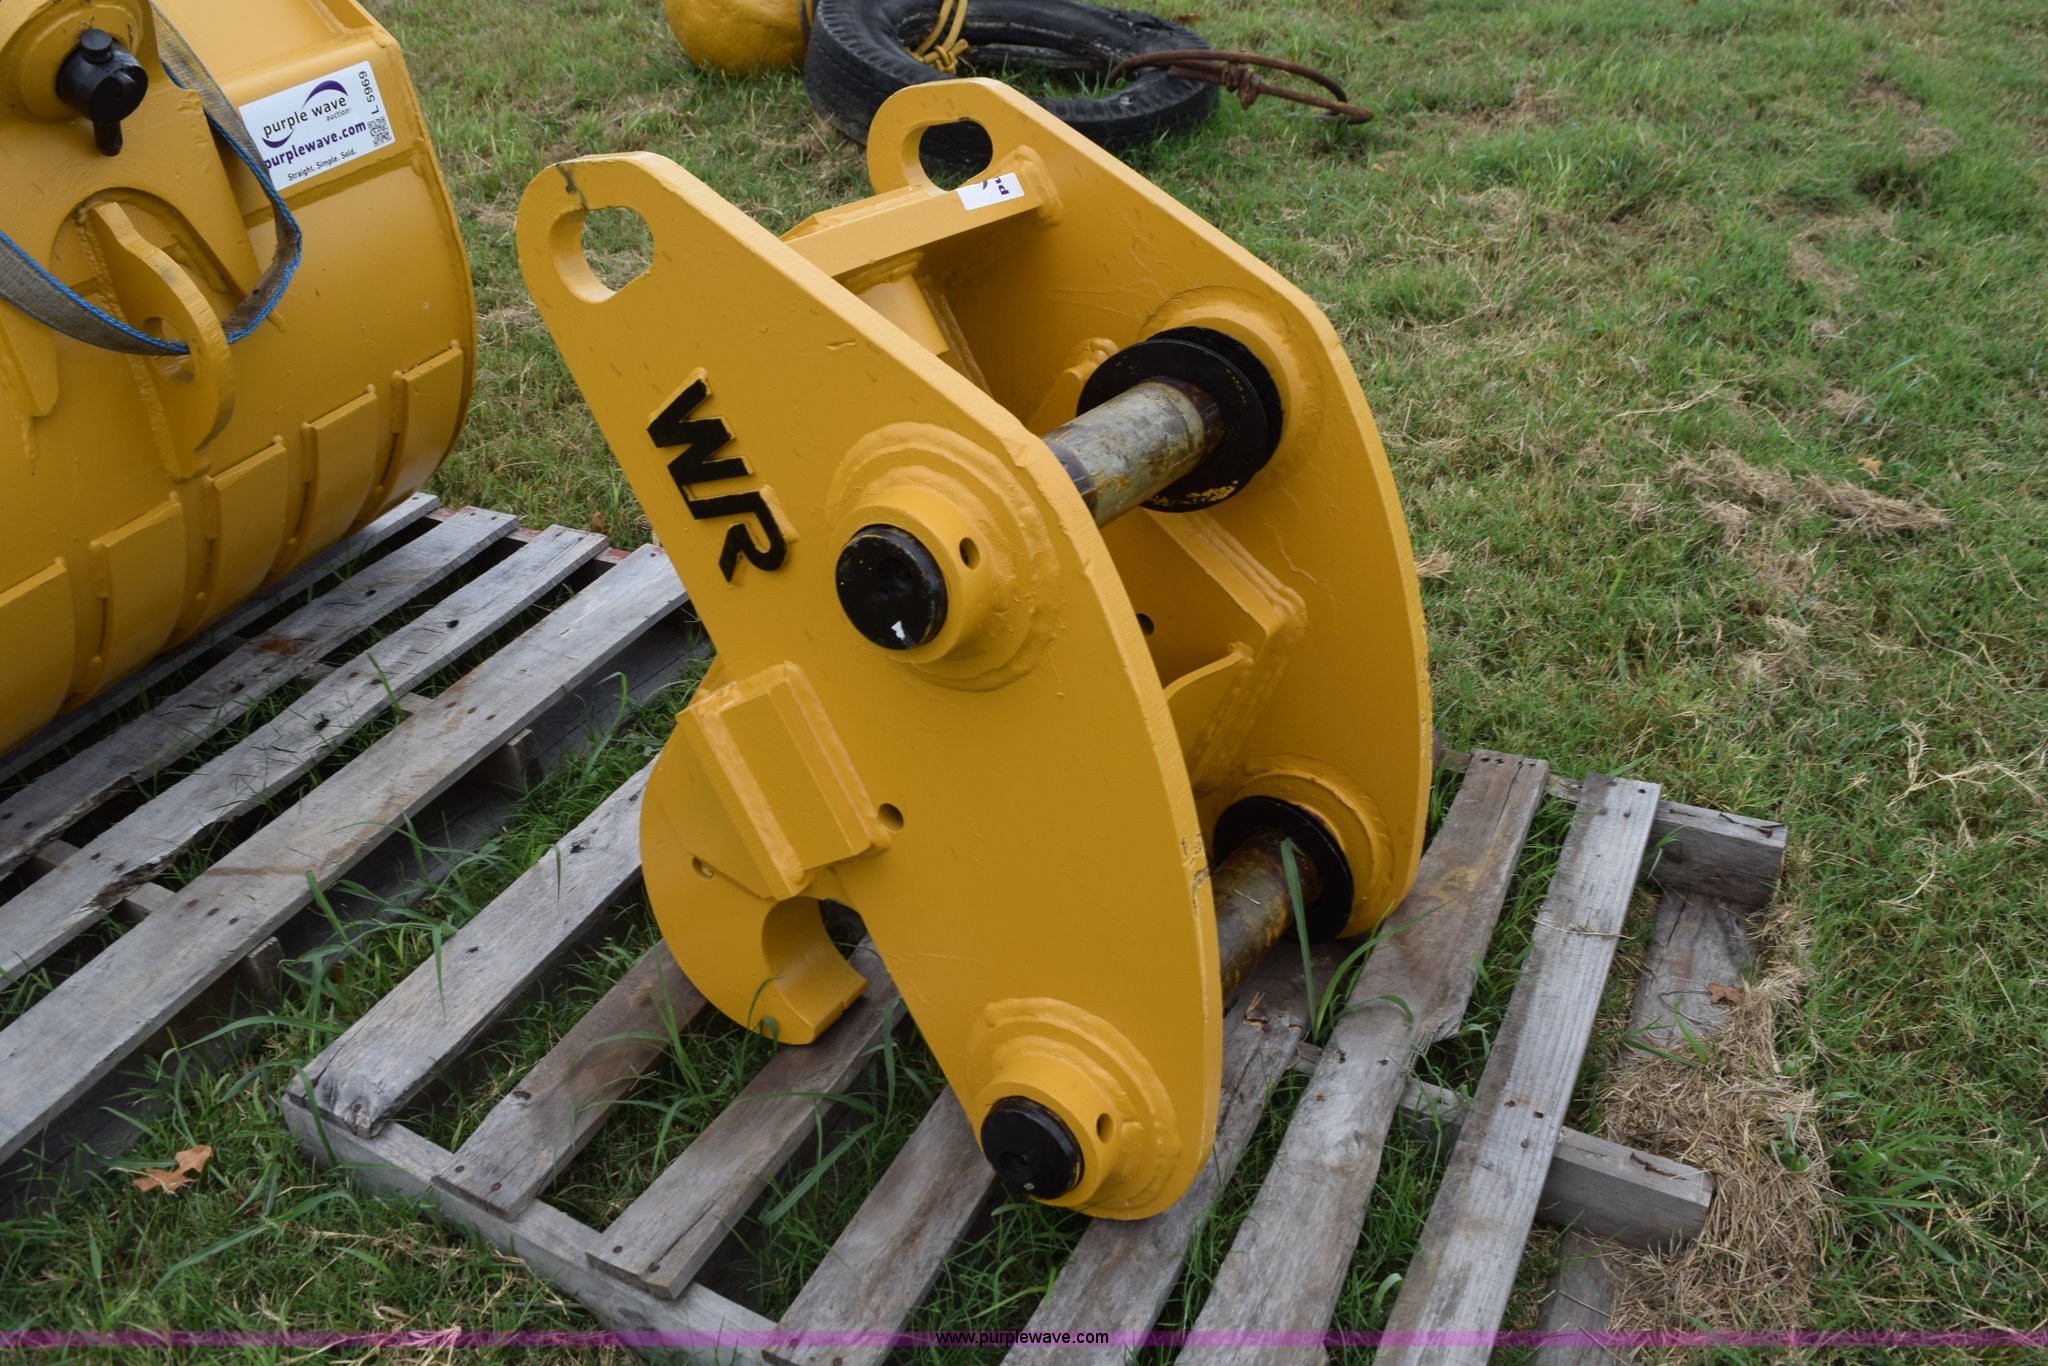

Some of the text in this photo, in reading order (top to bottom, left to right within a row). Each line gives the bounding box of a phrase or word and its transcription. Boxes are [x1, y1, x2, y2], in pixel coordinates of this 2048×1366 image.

[358, 71, 380, 115] L 5969
[263, 97, 347, 138] purple wave
[264, 122, 367, 169] purplewave.com
[287, 147, 357, 181] Straight. Simple. Sold.
